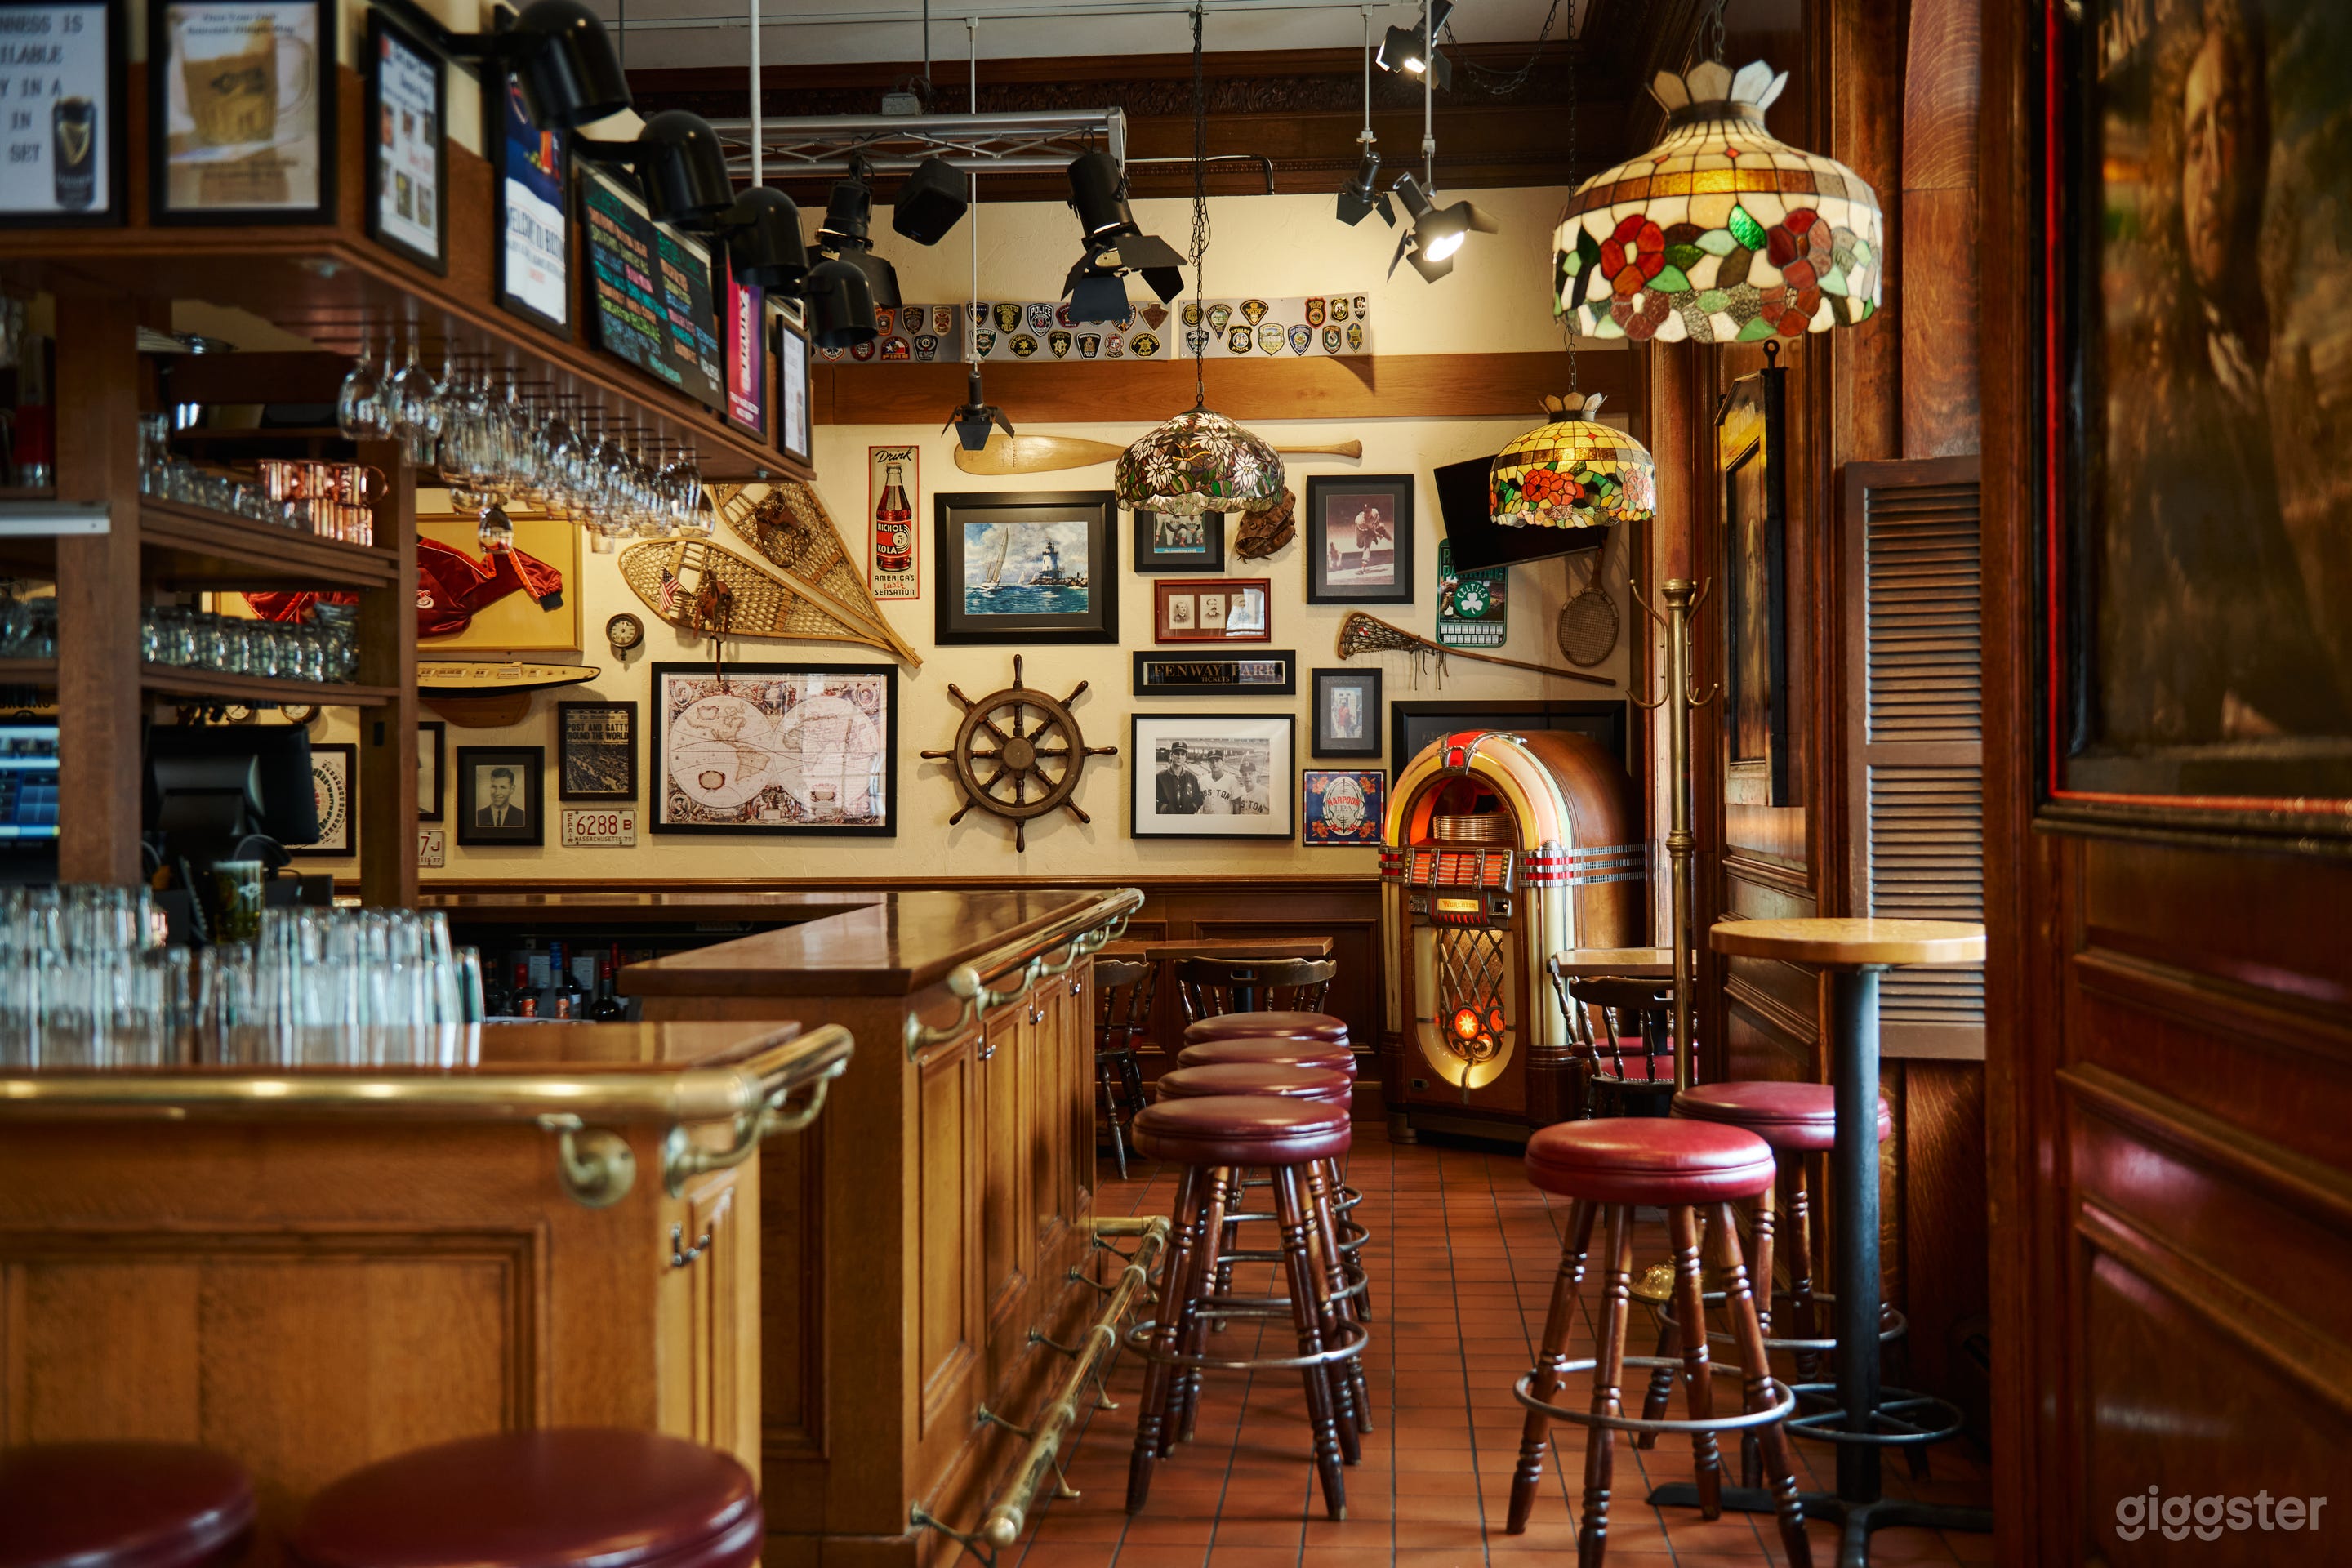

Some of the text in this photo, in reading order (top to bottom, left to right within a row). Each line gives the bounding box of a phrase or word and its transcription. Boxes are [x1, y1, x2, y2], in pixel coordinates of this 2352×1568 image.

[1031, 306, 1051, 317] POLICE
[875, 448, 911, 463] Drink
[877, 545, 898, 555] KOLA
[1456, 583, 1489, 599] CELTICS
[1153, 663, 1276, 677] FENWAY PARK
[567, 724, 629, 732] POST AND GATTY
[592, 732, 604, 740] THE
[606, 732, 629, 740] WORLD
[1326, 796, 1361, 807] HARPOON
[576, 815, 618, 835] 6288
[623, 819, 632, 831] B
